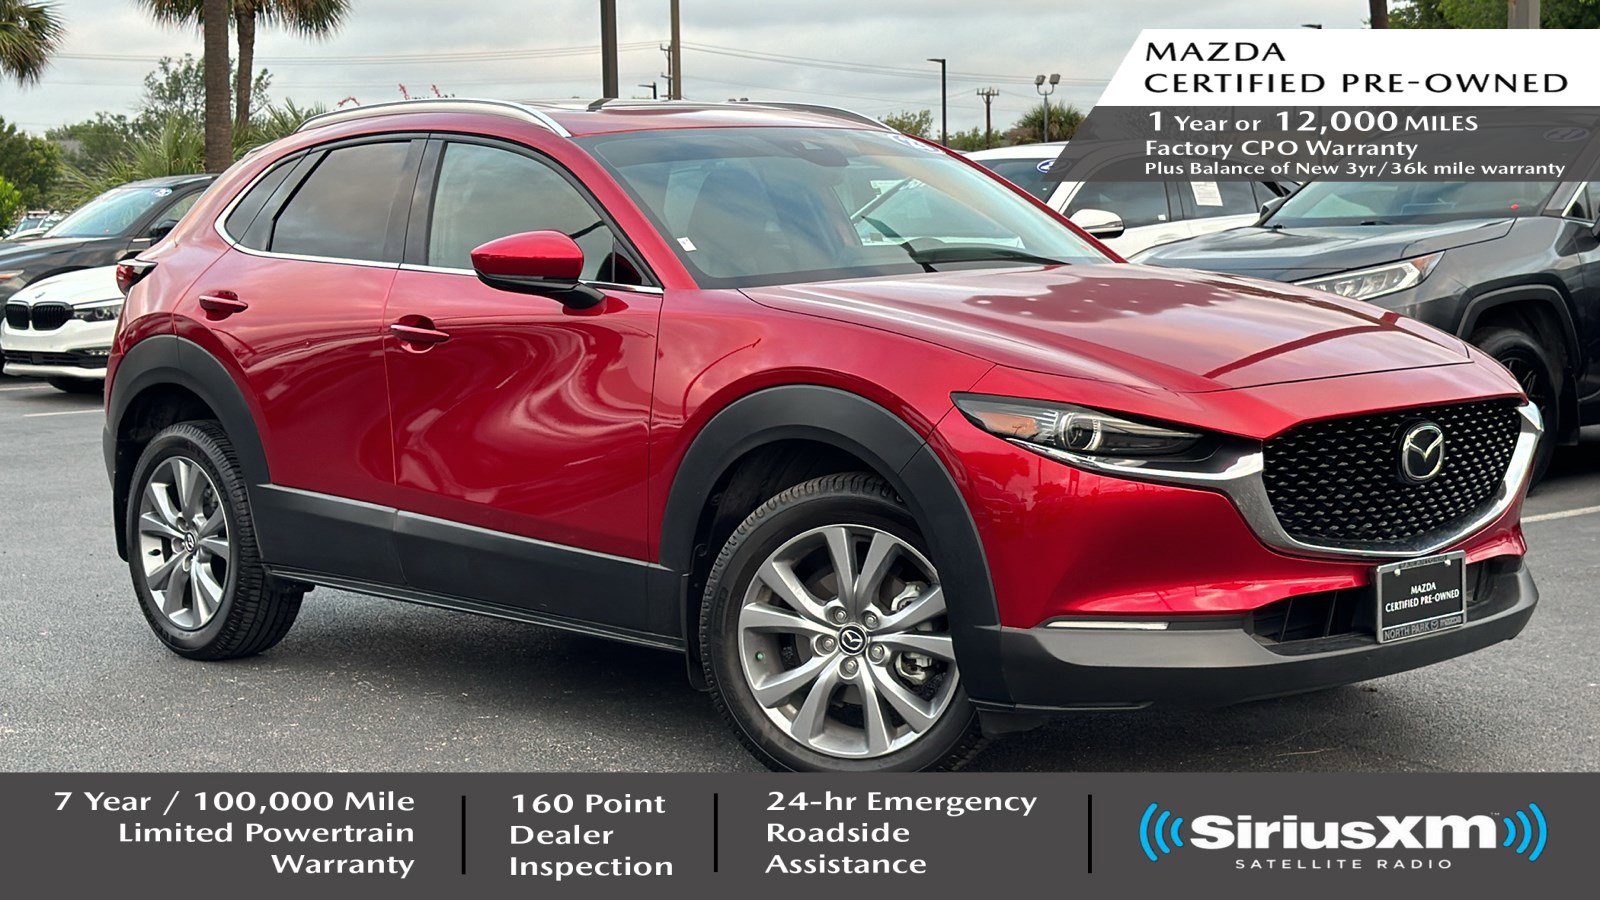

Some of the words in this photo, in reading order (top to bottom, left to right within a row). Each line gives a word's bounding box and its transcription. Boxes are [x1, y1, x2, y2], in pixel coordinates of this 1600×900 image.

[1410, 582, 1437, 595] MAZDA
[1385, 598, 1419, 613] CERTIFIED
[1420, 589, 1460, 605] PRE-OWNED
[1384, 626, 1410, 640] NORTH
[1411, 621, 1430, 634] PARK
